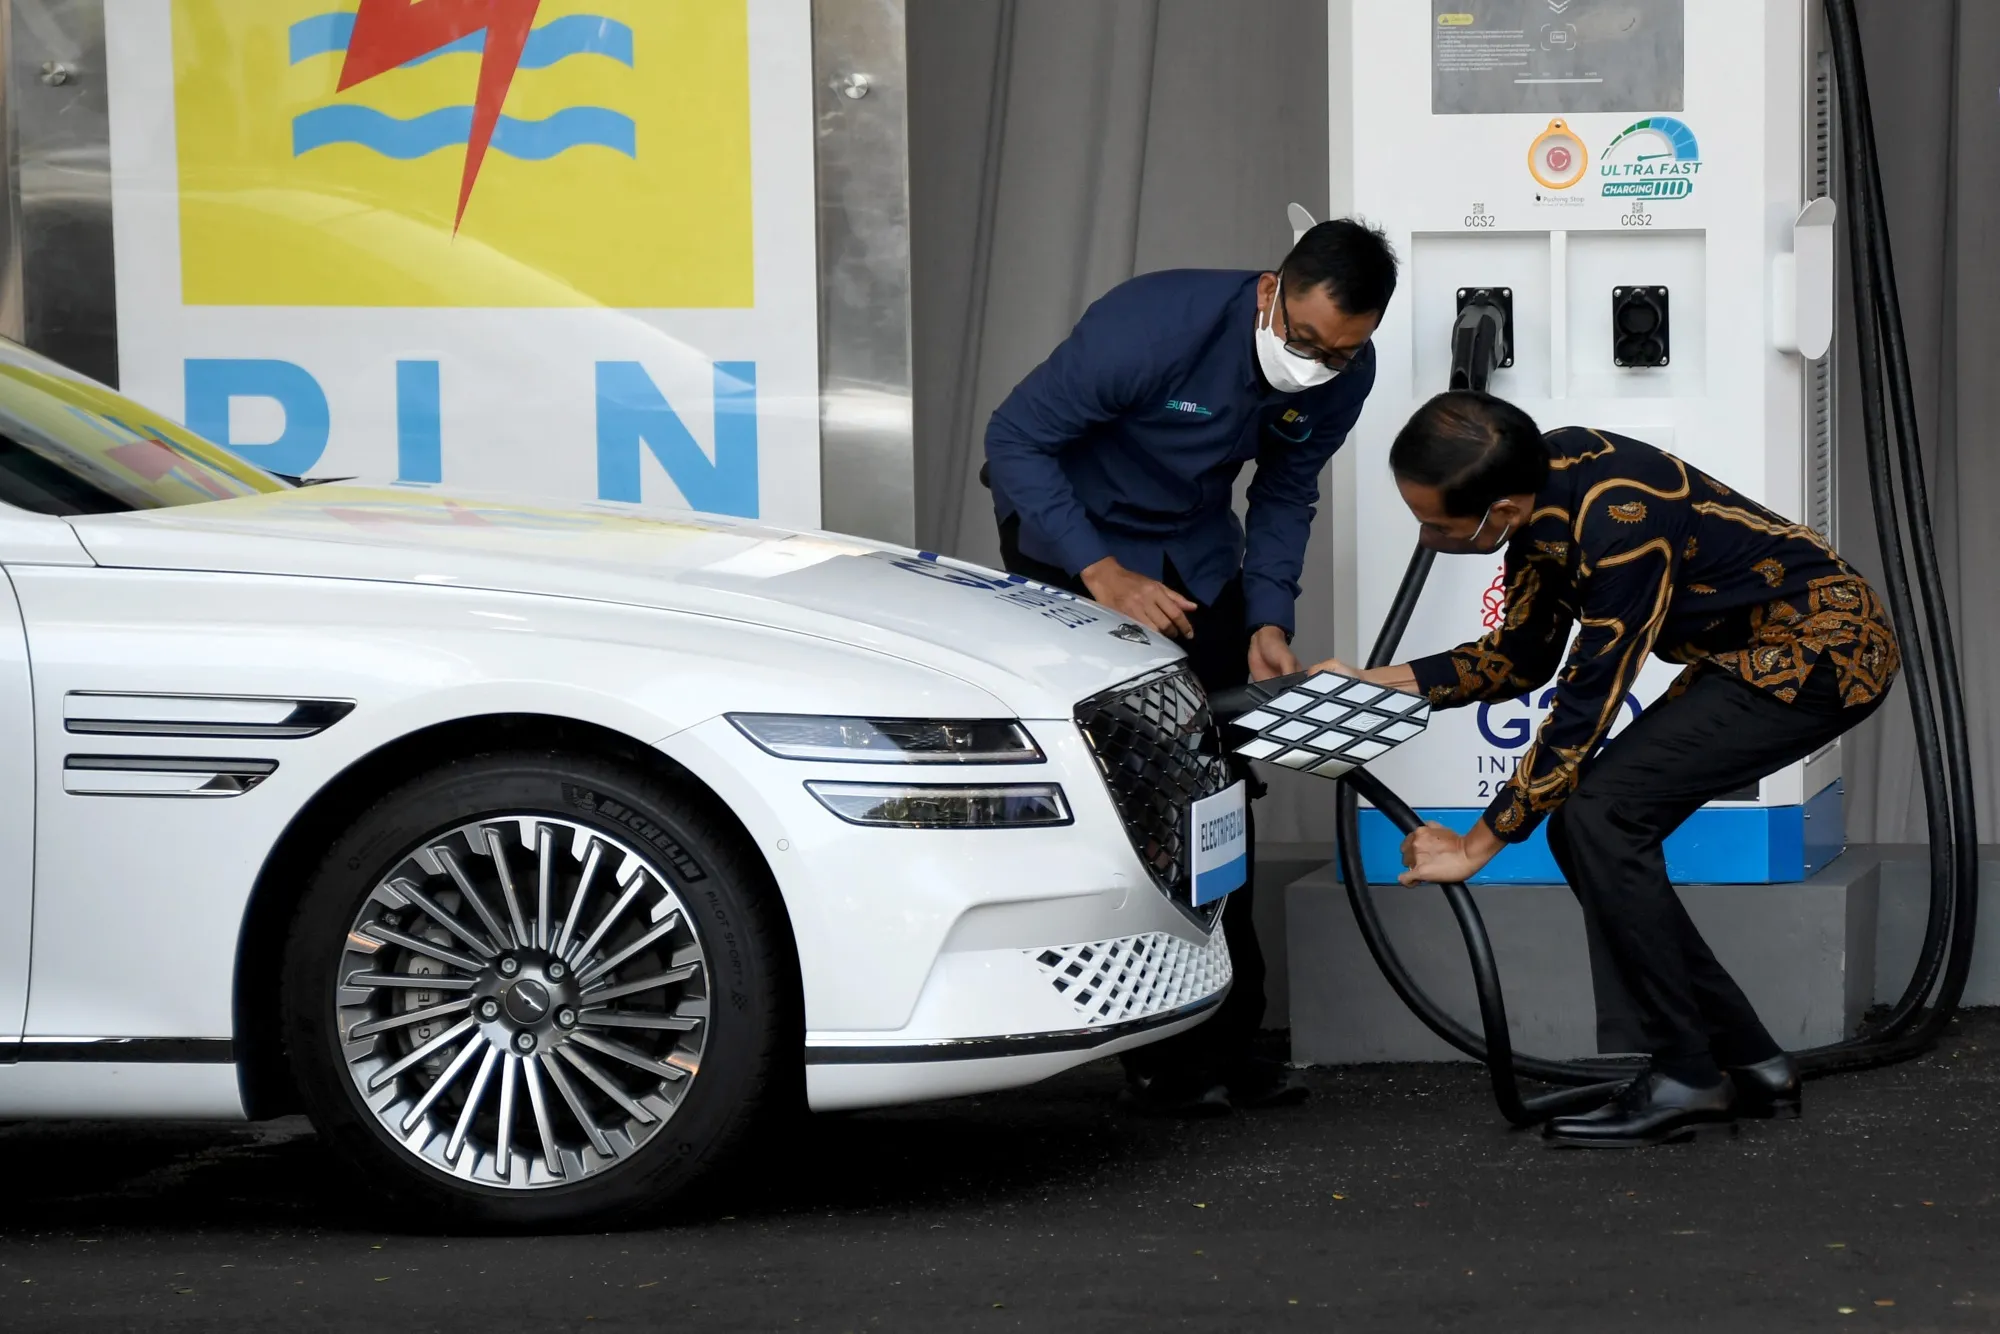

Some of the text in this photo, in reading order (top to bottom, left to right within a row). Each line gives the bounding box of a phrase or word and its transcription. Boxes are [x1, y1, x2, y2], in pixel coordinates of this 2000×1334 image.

[1600, 162, 1703, 176] ULTRA FAST
[1603, 183, 1653, 194] CHARGING
[1464, 215, 1496, 227] CCS2
[1621, 214, 1653, 226] CCS2
[598, 799, 702, 879] MICHELIN
[705, 890, 744, 976] PILOT SPORT
